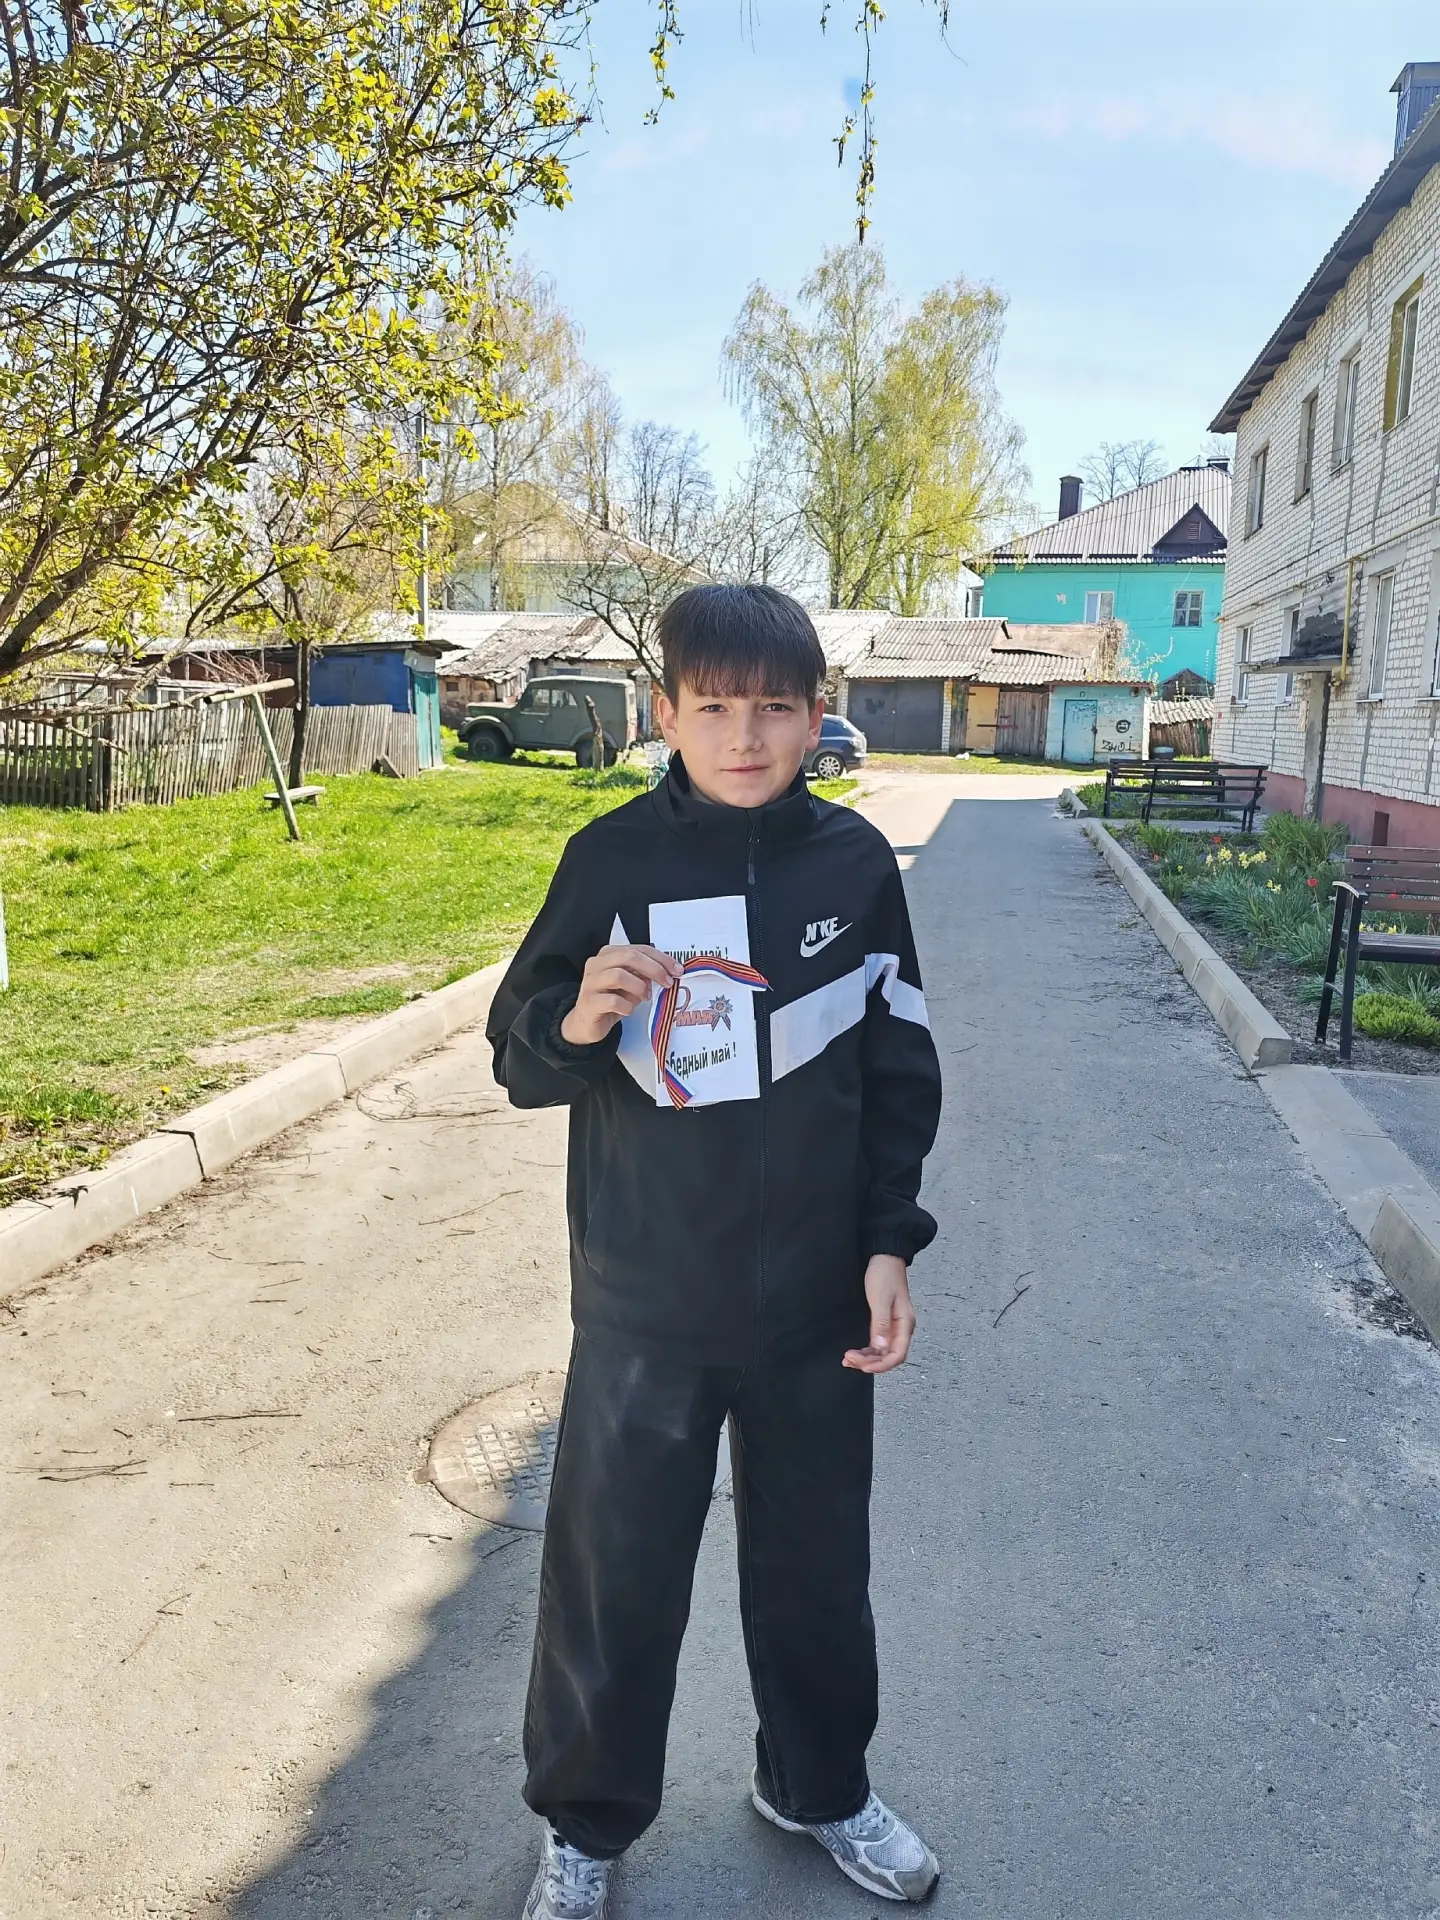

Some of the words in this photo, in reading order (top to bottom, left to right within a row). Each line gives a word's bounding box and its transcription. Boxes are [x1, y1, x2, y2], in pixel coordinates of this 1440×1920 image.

[805, 916, 839, 943] NKE
[657, 1045, 709, 1085] бедный
[711, 1042, 731, 1065] май
